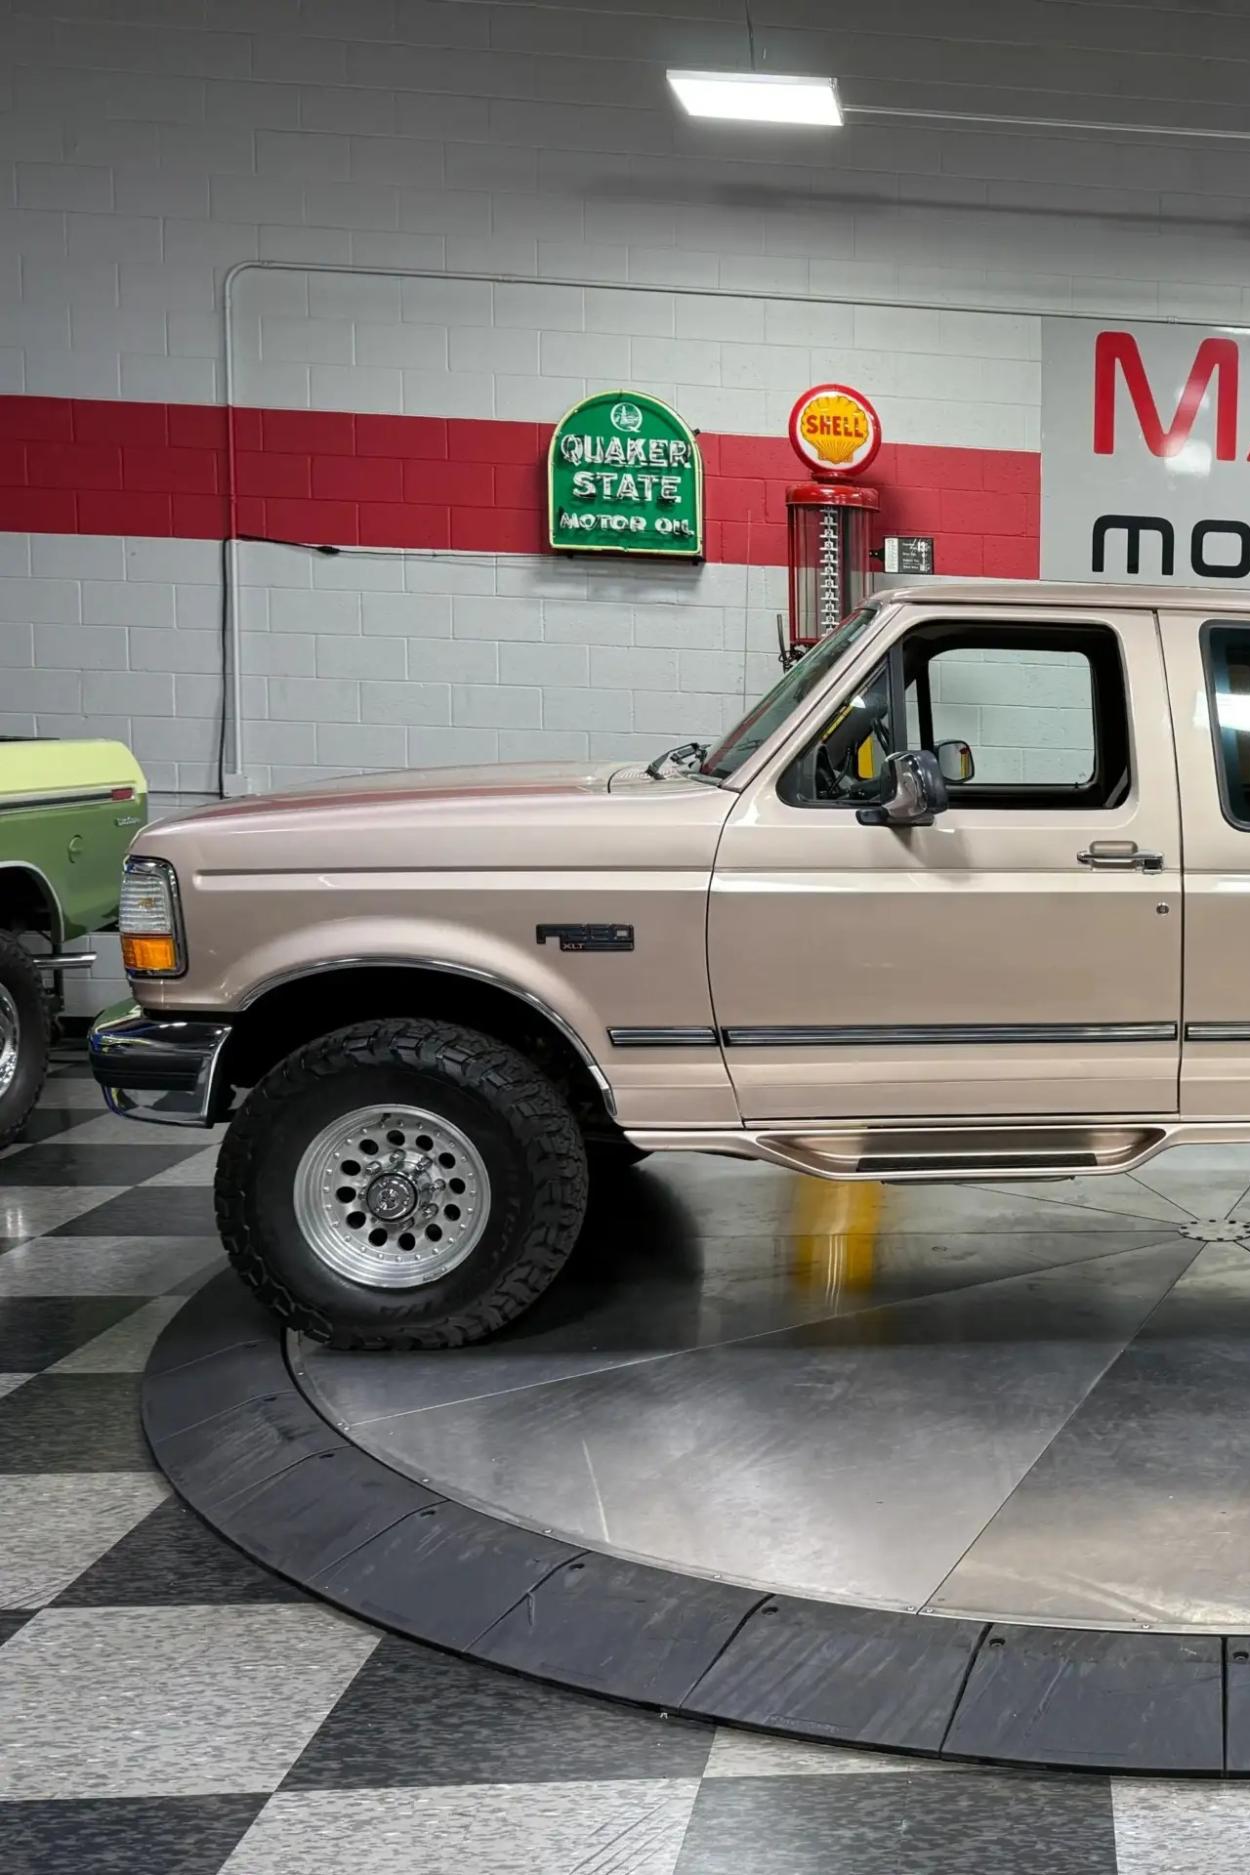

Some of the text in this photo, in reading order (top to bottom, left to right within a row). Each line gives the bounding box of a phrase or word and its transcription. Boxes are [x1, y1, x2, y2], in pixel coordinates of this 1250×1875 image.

[806, 414, 864, 438] SHELL
[560, 434, 692, 468] QUAKER
[573, 470, 682, 503] STATE
[560, 512, 695, 537] MOTOR OIL
